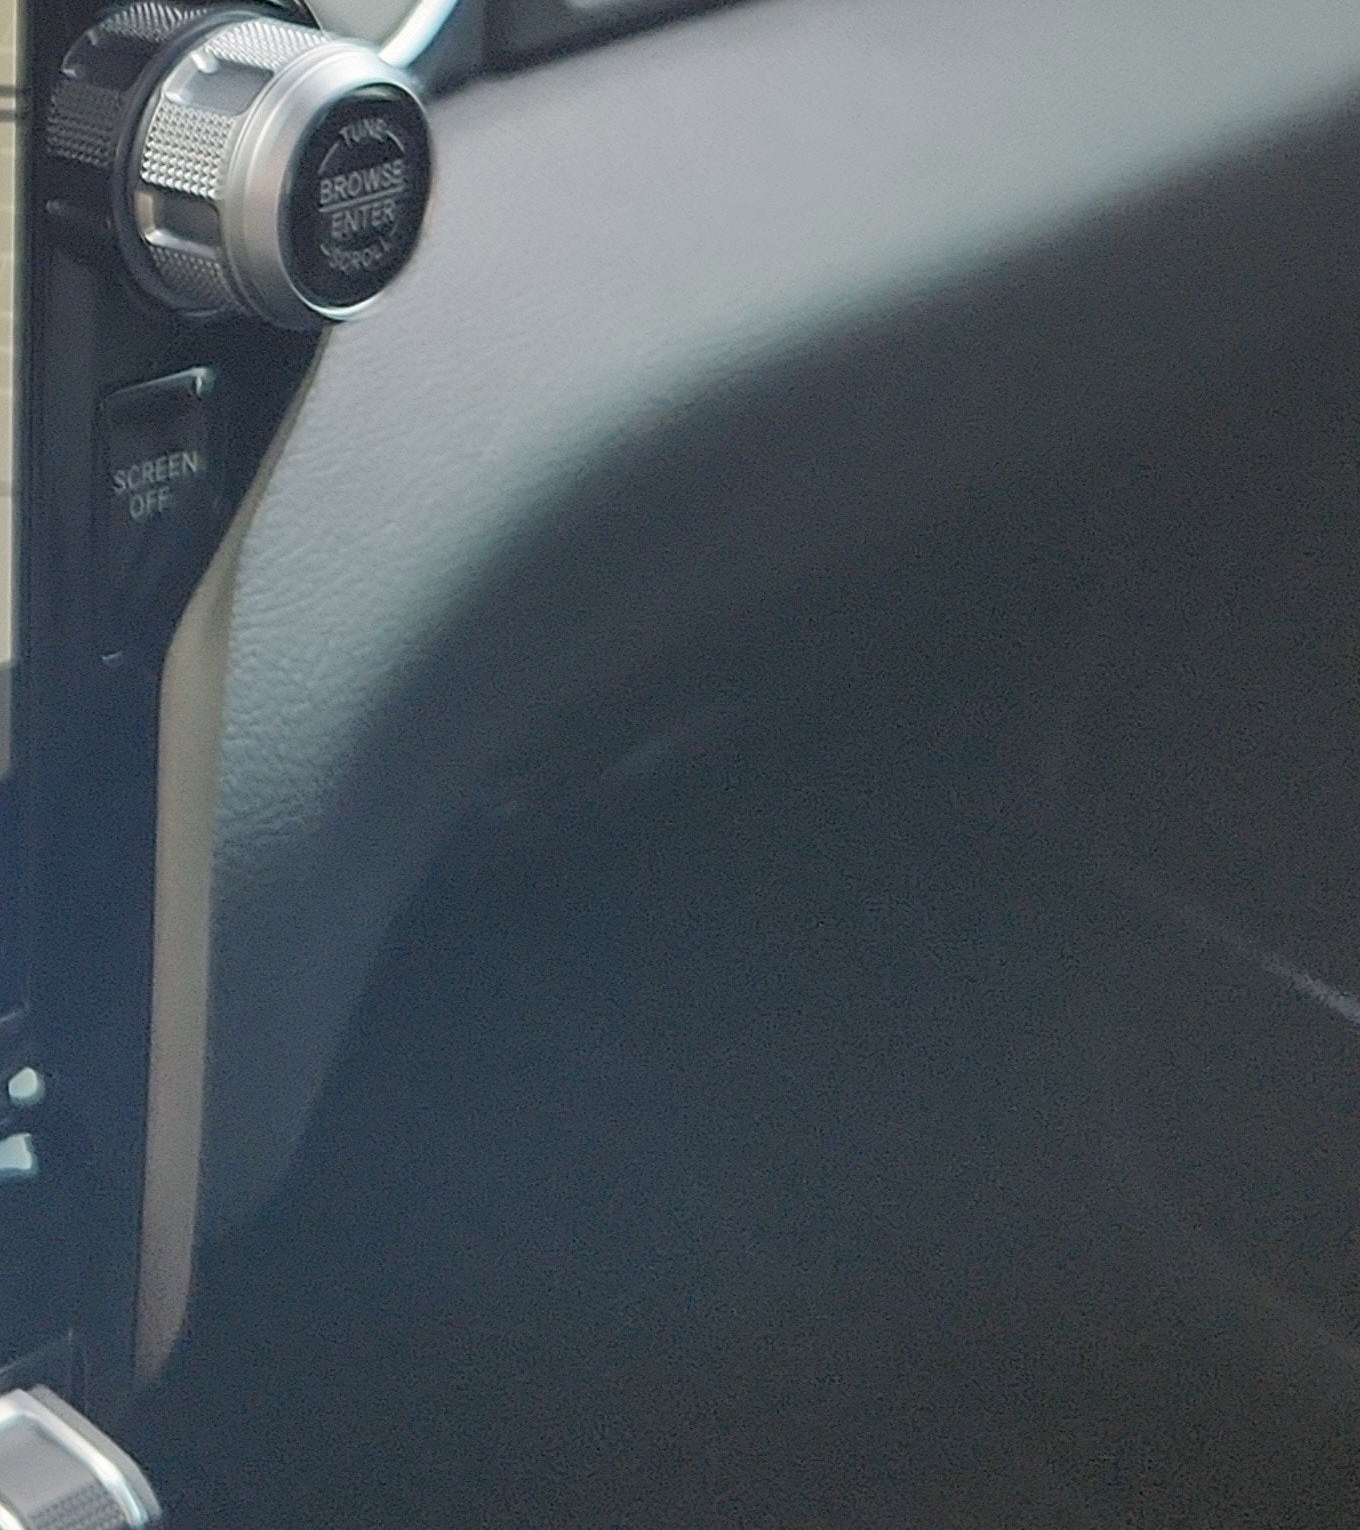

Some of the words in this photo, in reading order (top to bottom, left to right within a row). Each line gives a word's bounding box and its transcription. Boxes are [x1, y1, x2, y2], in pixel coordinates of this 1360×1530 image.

[338, 117, 389, 149] TUNE
[318, 158, 405, 206] BROWSE
[330, 198, 396, 241] ENTER
[112, 449, 200, 496] SCREEN
[129, 484, 172, 521] OFF
